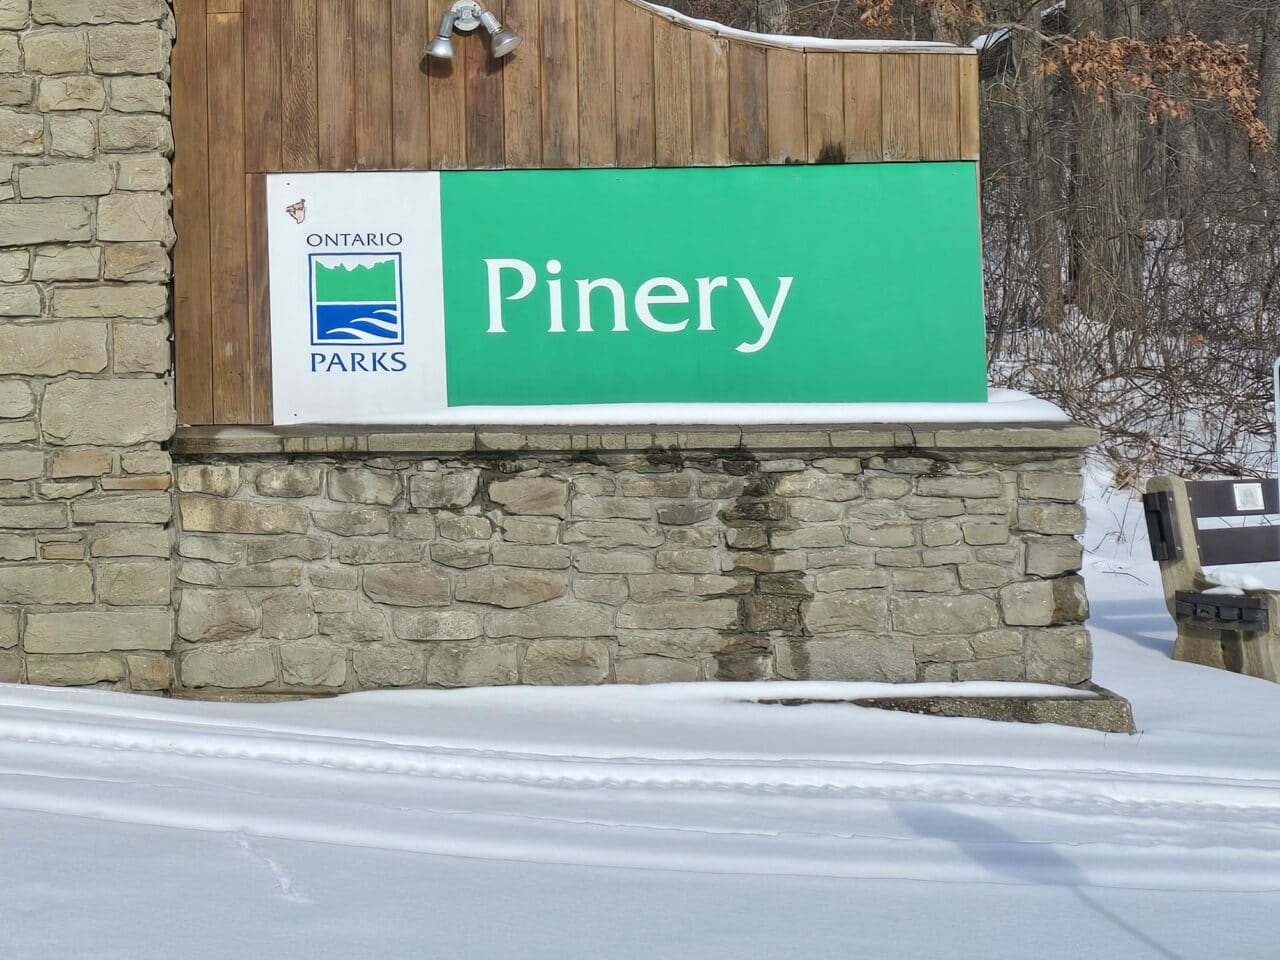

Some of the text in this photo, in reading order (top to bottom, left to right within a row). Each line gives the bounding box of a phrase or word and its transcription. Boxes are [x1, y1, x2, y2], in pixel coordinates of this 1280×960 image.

[306, 232, 403, 247] ONTARIO
[483, 258, 794, 354] Pinery
[311, 352, 407, 372] PARKS
